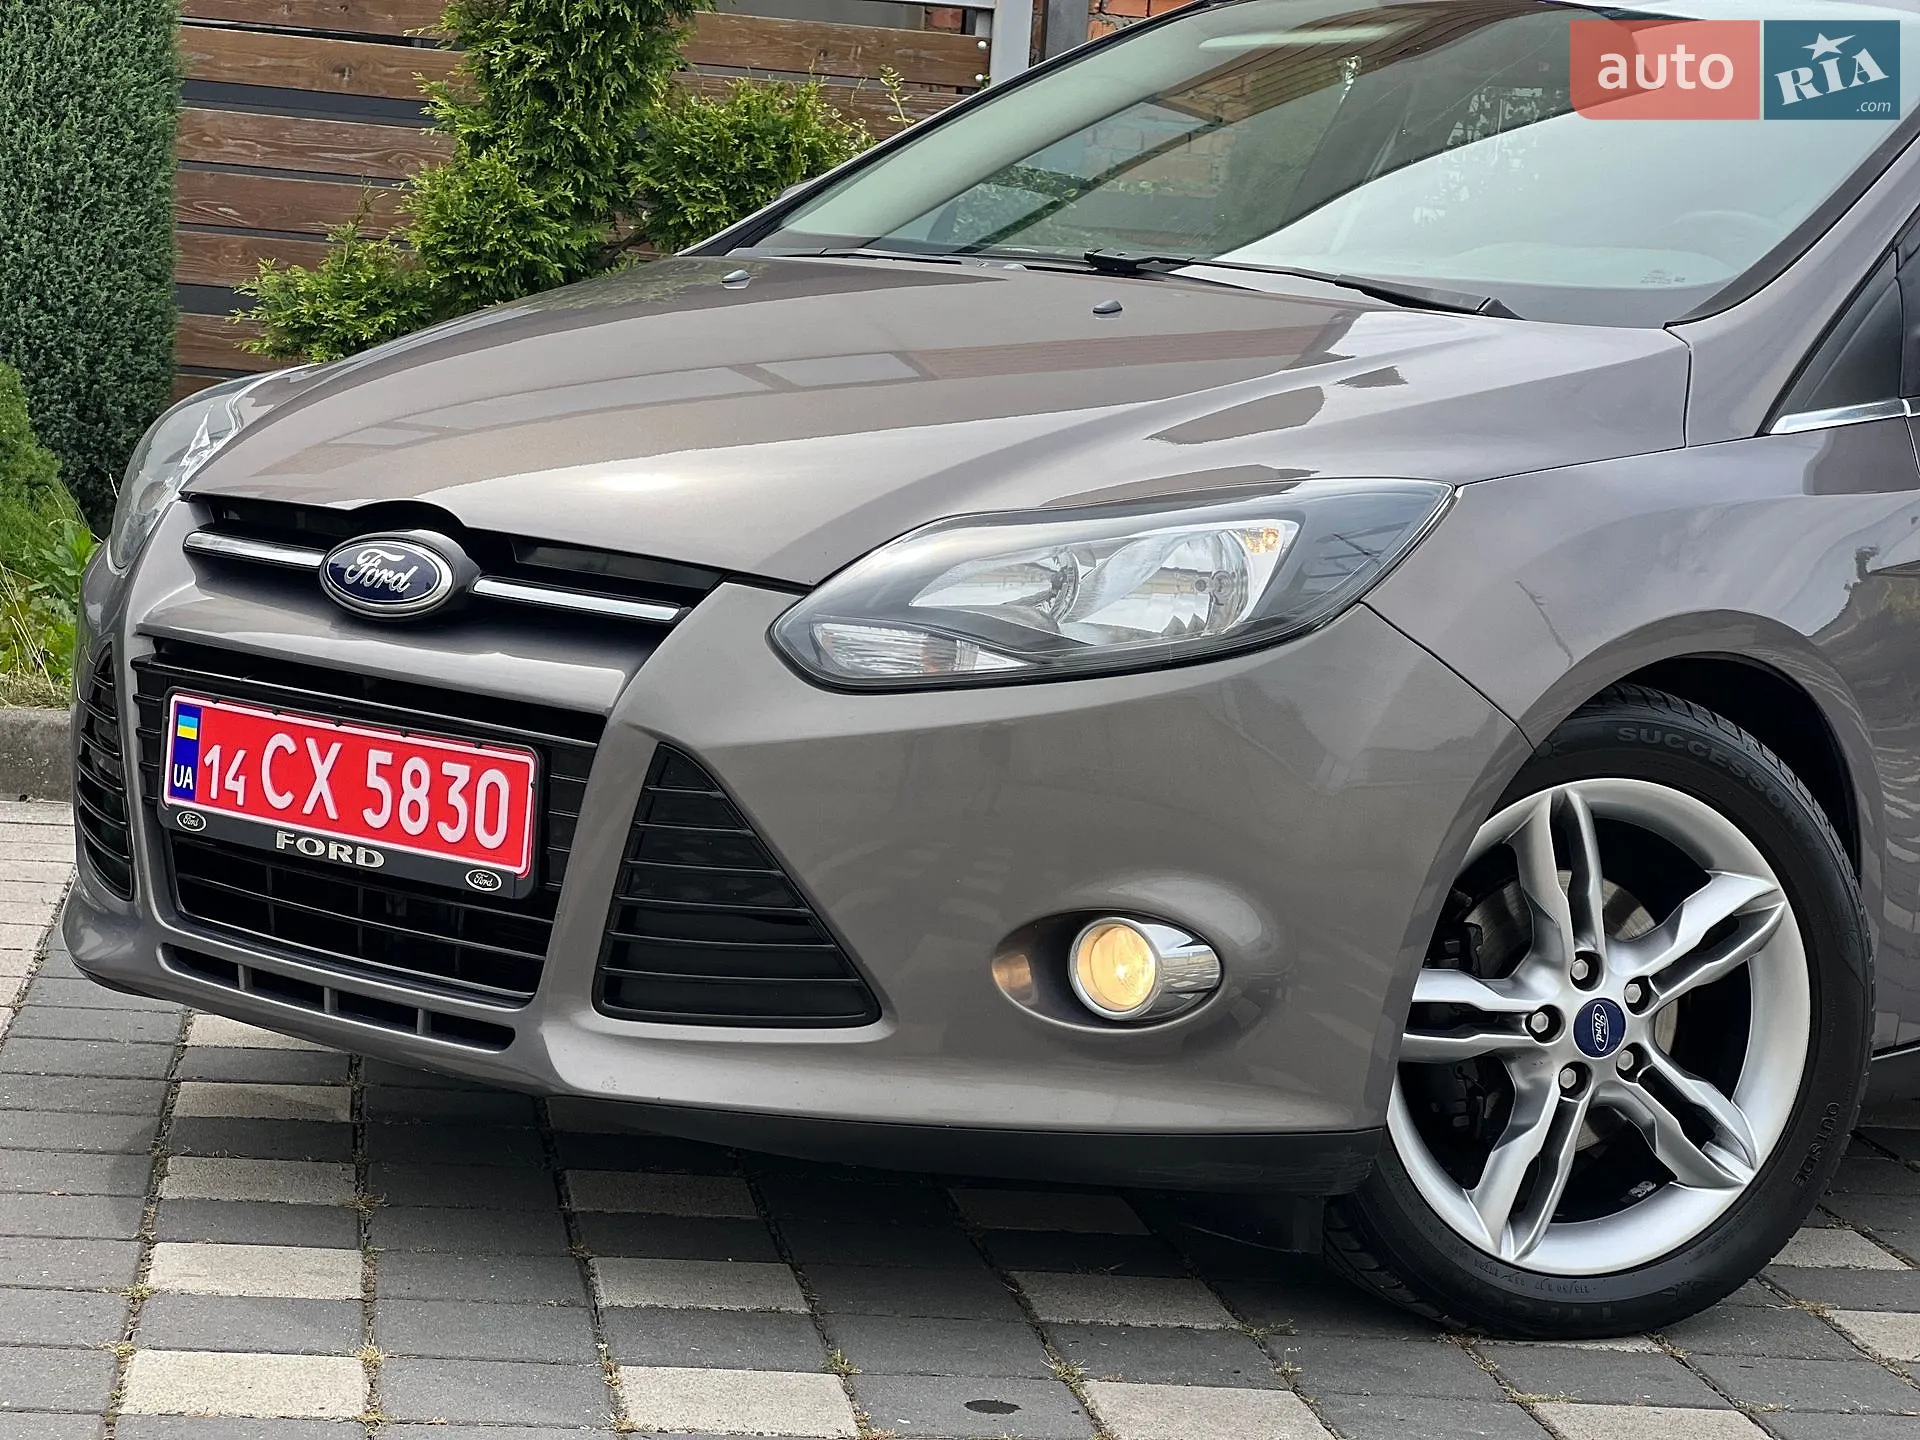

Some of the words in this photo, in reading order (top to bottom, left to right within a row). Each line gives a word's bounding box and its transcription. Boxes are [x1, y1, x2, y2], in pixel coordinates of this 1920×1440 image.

[344, 548, 419, 593] Ford
[173, 763, 193, 790] UA
[203, 744, 247, 806] 14
[260, 732, 343, 820] CX
[361, 748, 510, 850] 5830
[182, 813, 200, 827] Ford
[275, 830, 385, 869] FORD
[473, 872, 493, 887] Ford
[1594, 1012, 1607, 1043] Ford
